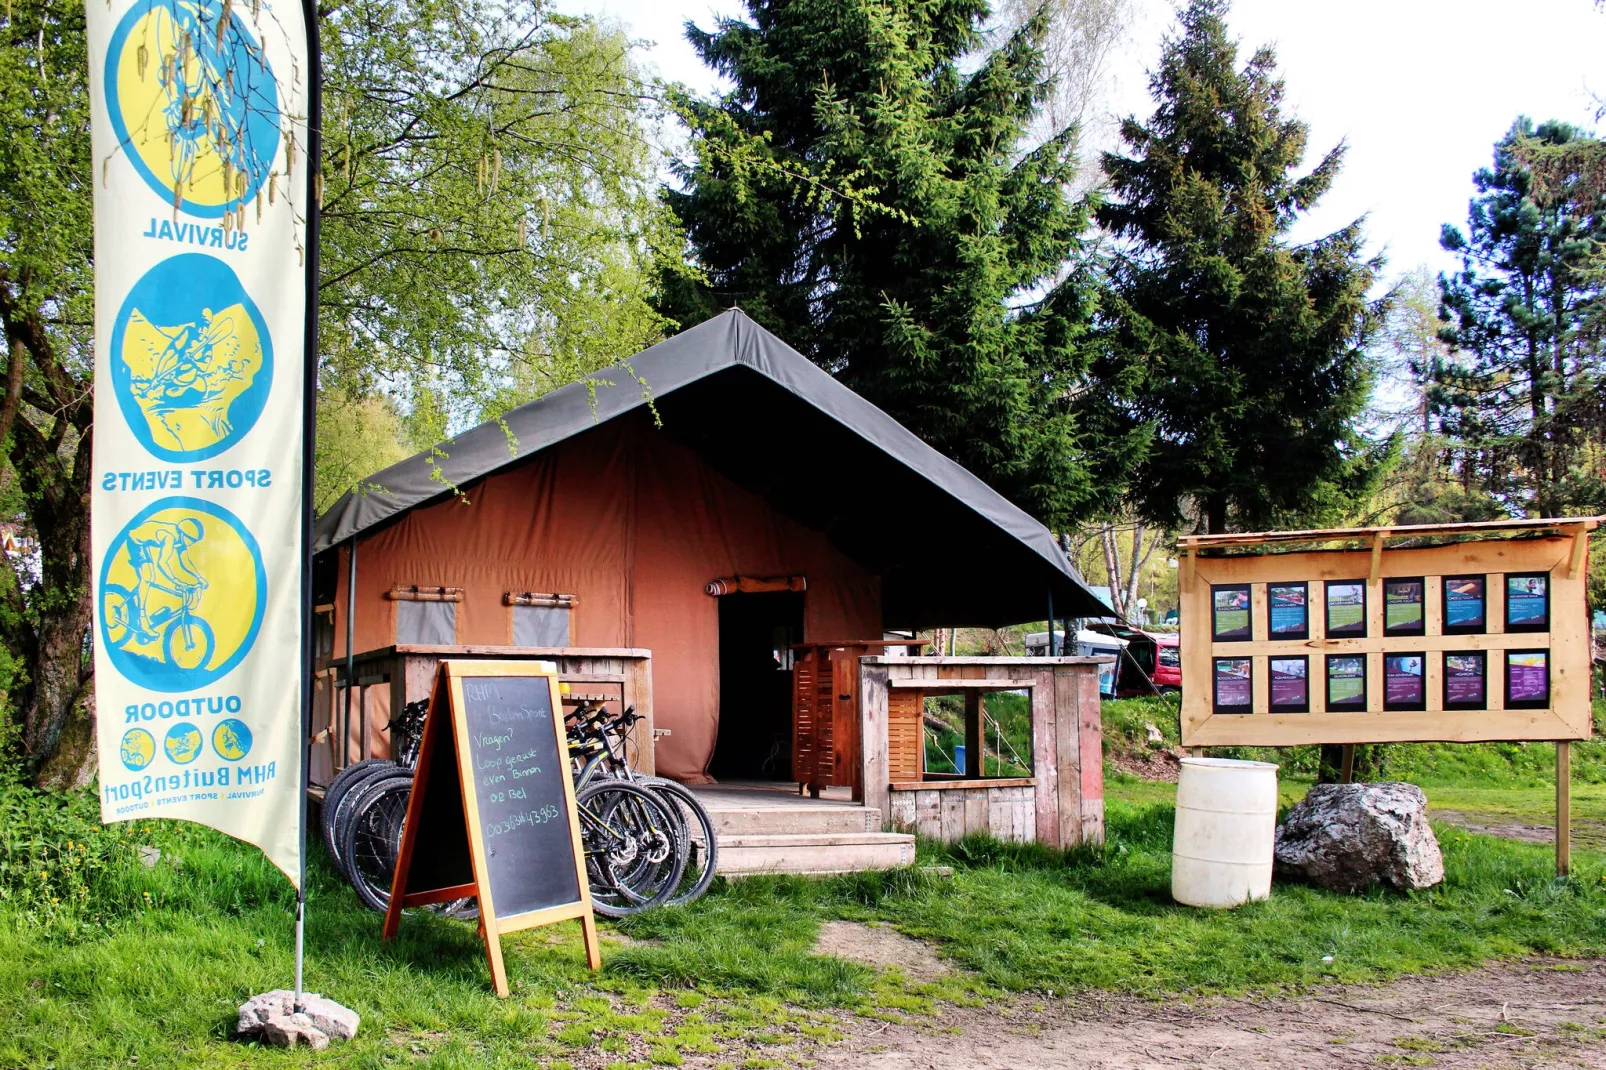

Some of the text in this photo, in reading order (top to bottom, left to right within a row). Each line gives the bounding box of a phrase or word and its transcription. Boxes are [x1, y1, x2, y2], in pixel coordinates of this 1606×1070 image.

[466, 683, 499, 702] RHM
[476, 753, 502, 770] Loop
[483, 775, 506, 787] even
[508, 787, 528, 799] Bel
